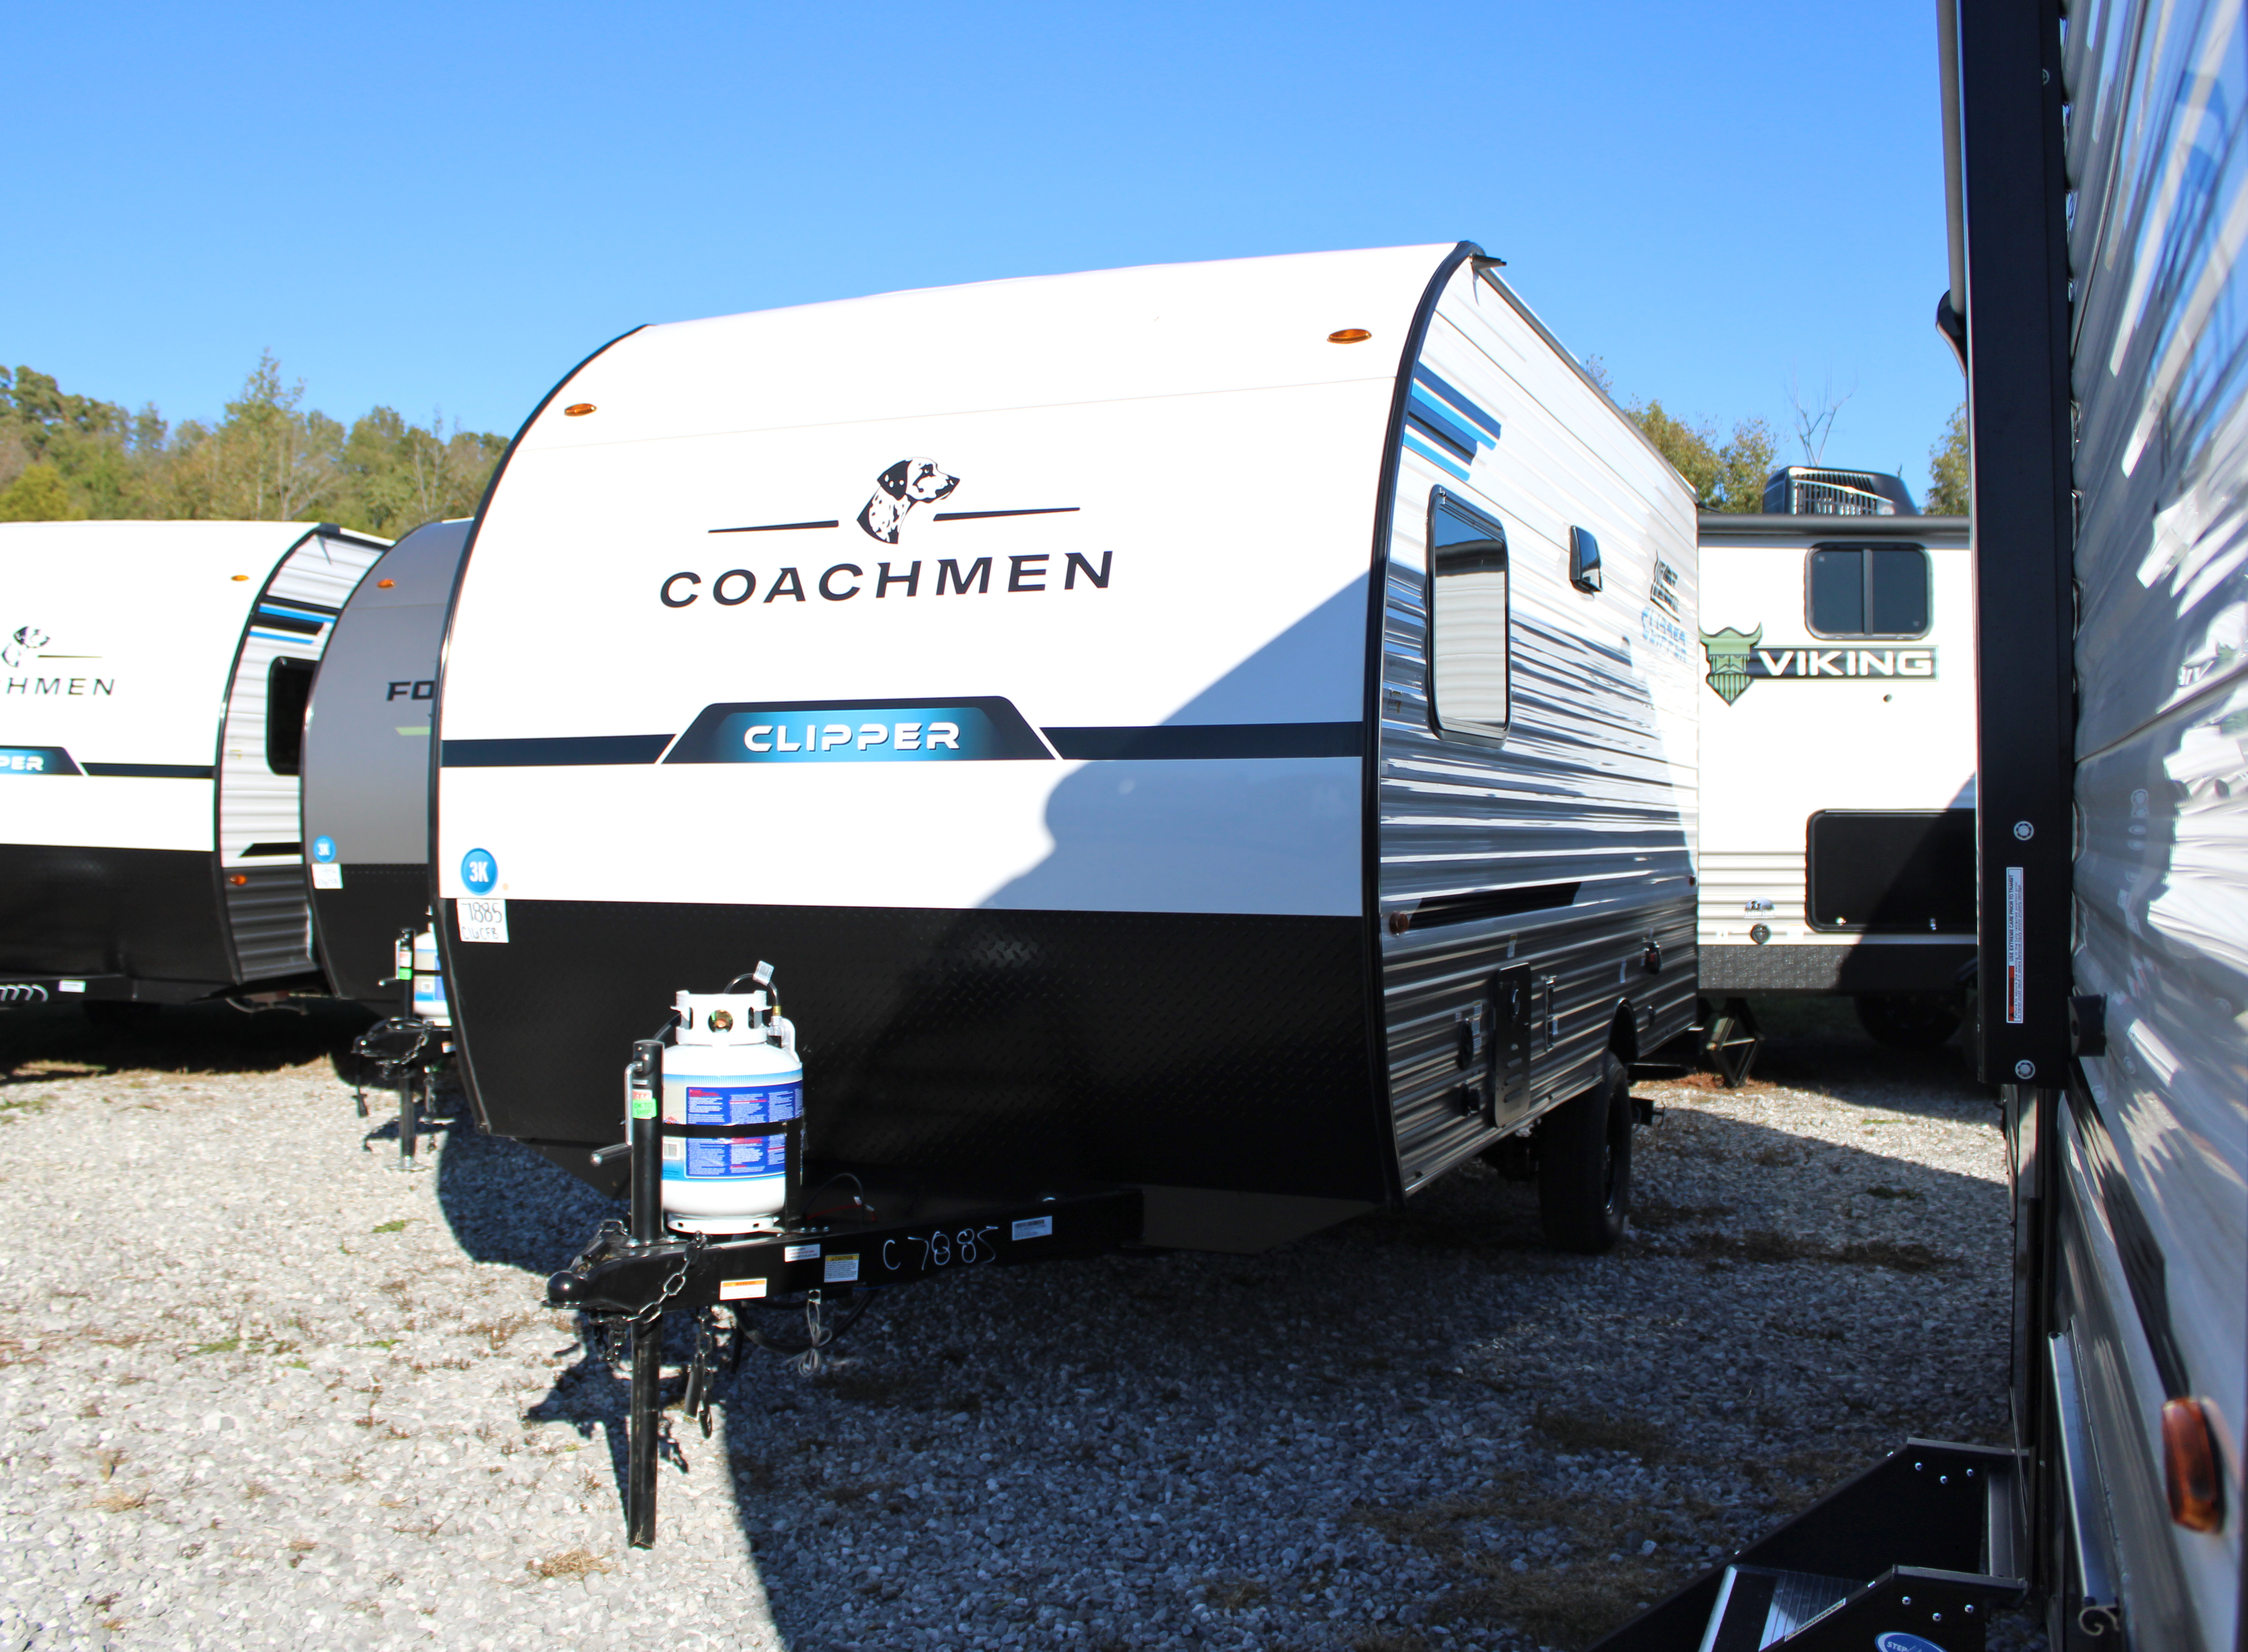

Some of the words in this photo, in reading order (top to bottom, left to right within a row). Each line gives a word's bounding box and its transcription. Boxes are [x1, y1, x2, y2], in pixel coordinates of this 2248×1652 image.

[660, 551, 1113, 608] COACHMEN
[1758, 650, 1932, 676] VIKING
[743, 721, 961, 753] CLIPPER
[318, 843, 331, 856] 3K
[469, 861, 489, 883] 3K
[461, 902, 502, 923] 7885
